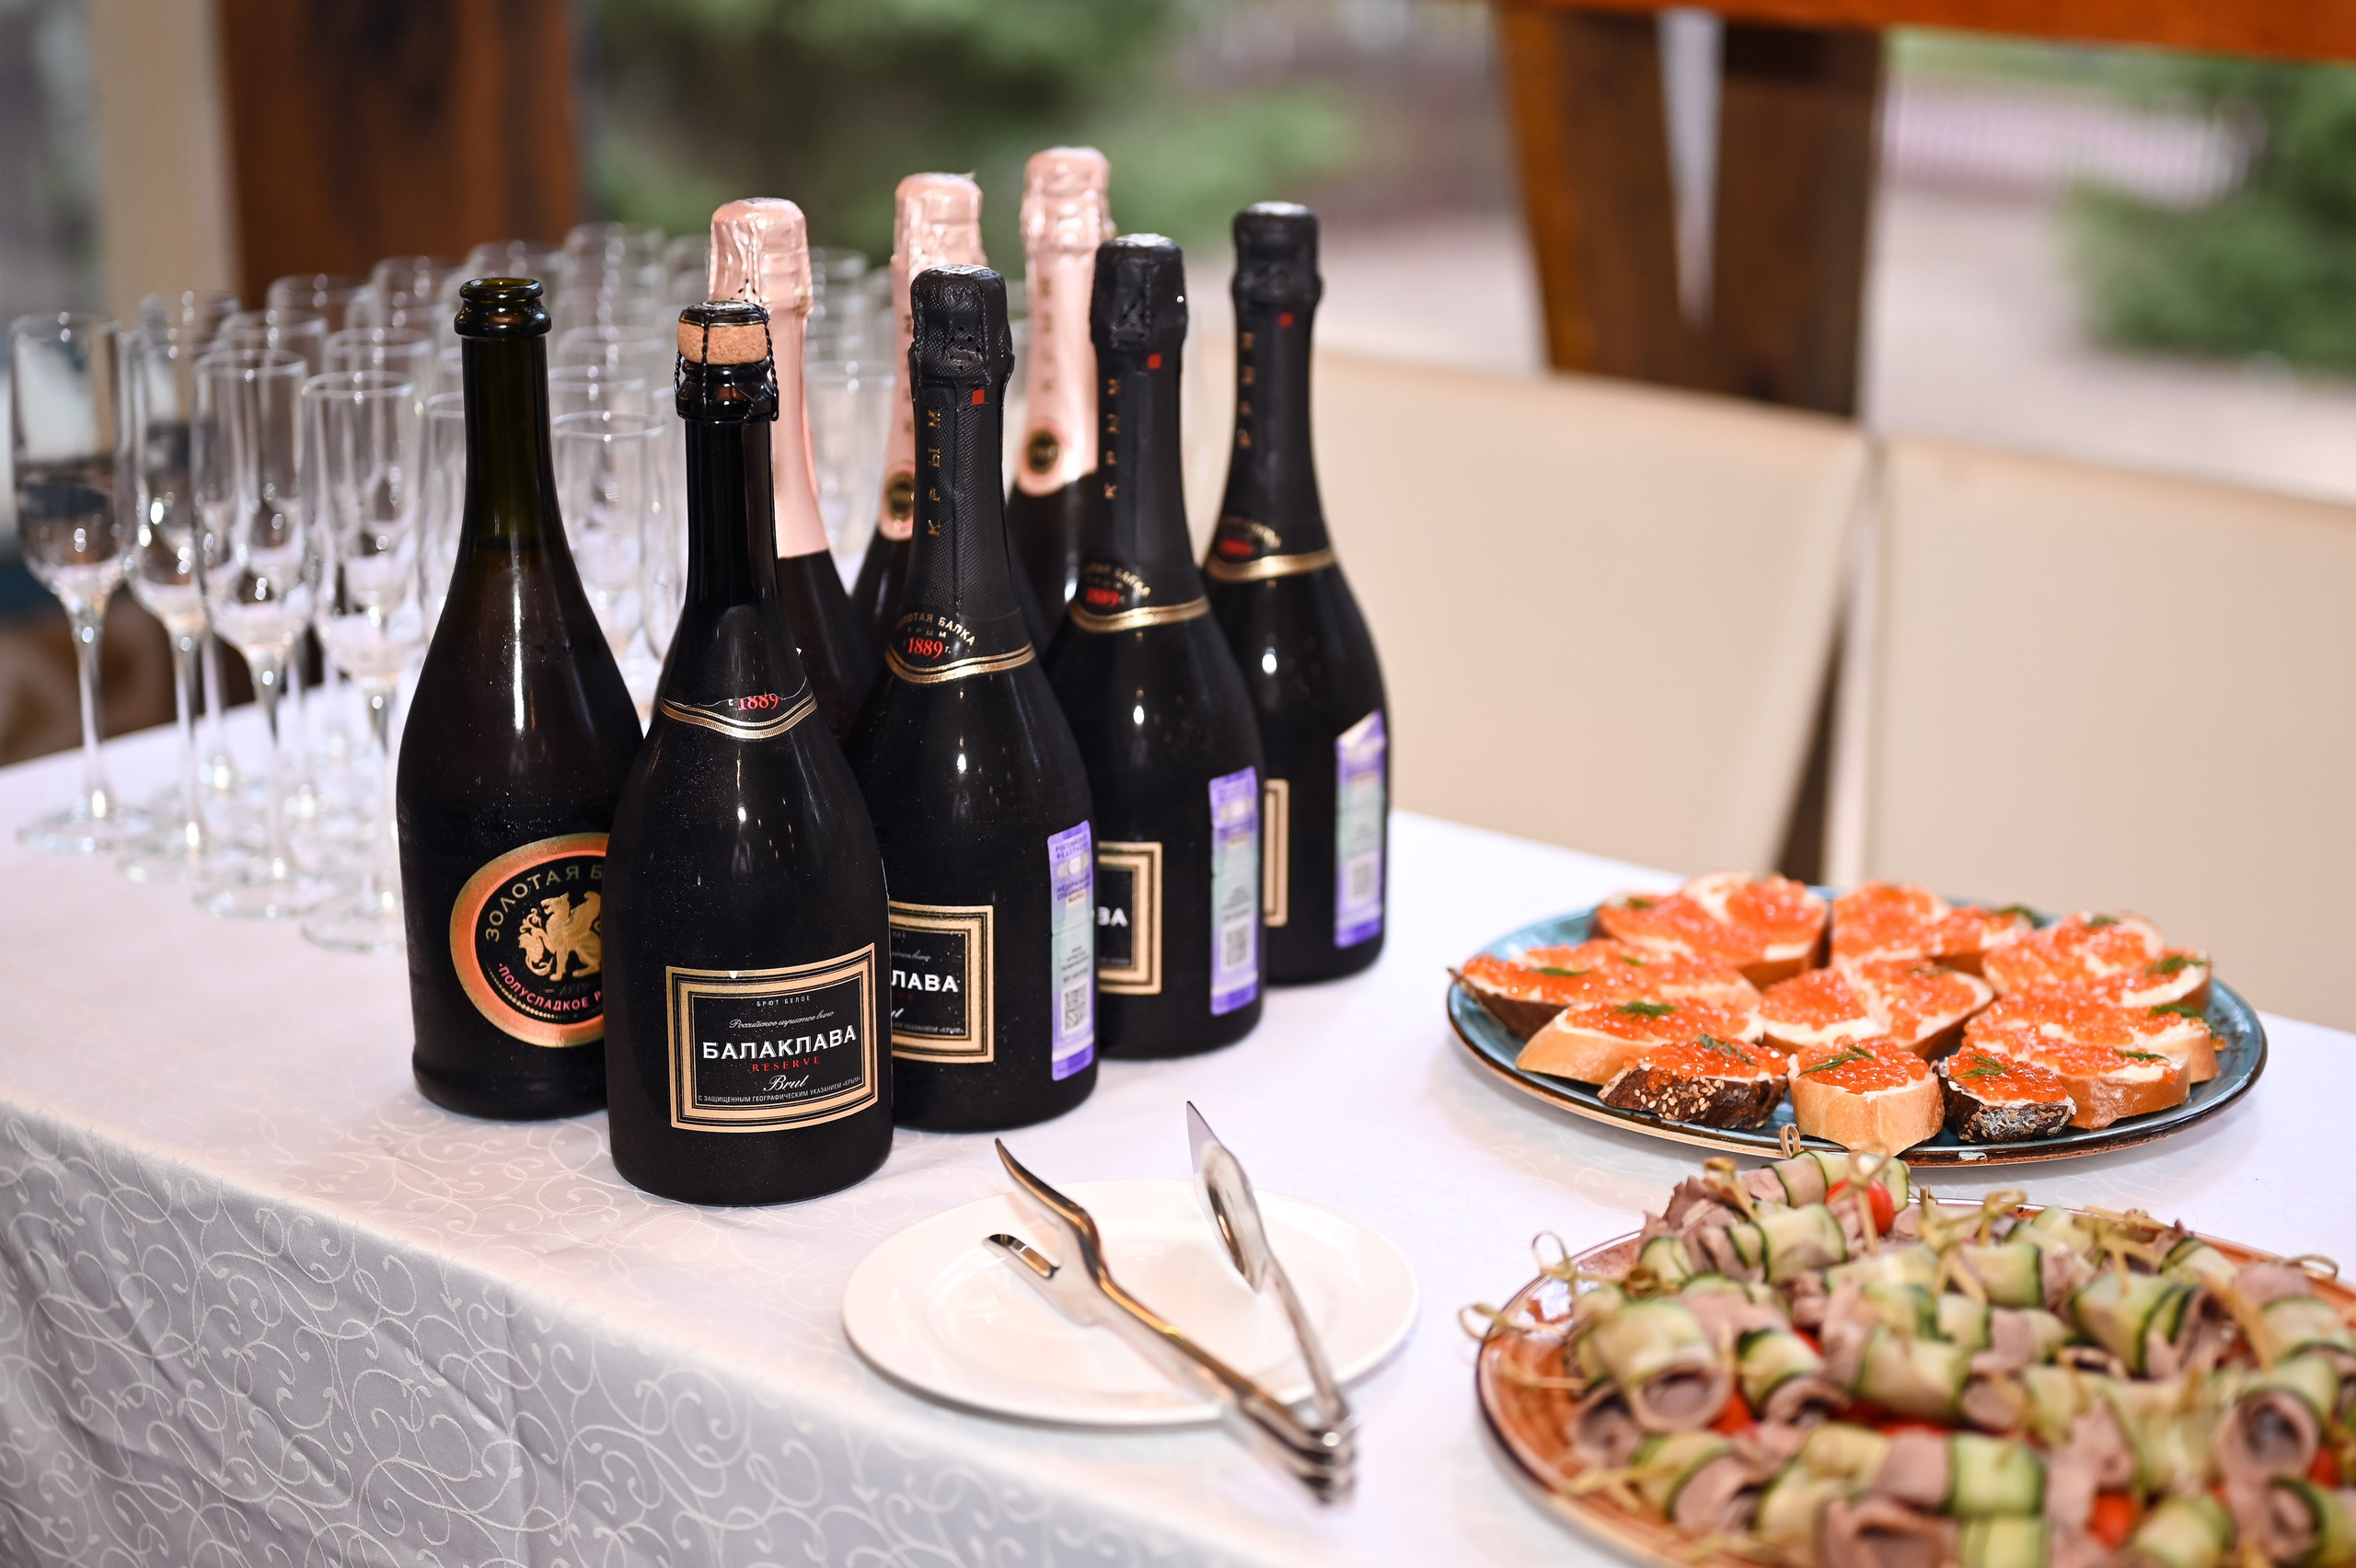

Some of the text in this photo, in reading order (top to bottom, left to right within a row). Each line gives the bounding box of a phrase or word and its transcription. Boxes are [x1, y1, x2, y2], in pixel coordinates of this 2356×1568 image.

[928, 409, 941, 536] КРЫМ
[938, 617, 976, 646] БАЛКА
[907, 637, 943, 660] 1889
[739, 693, 780, 710] 1889
[486, 864, 580, 942] ЗОЛОТАЯ
[784, 995, 810, 1005] БЕЛОЕ
[702, 1024, 858, 1060] БАЛАКЛАВА
[752, 1055, 820, 1072] RESERVE
[703, 1095, 751, 1103] ЗАЩИЩЕННЫМ
[752, 1090, 809, 1102] ГЕОГРАФИЧЕСКИМ
[809, 1082, 842, 1096] УКАЗАНИЕМ
